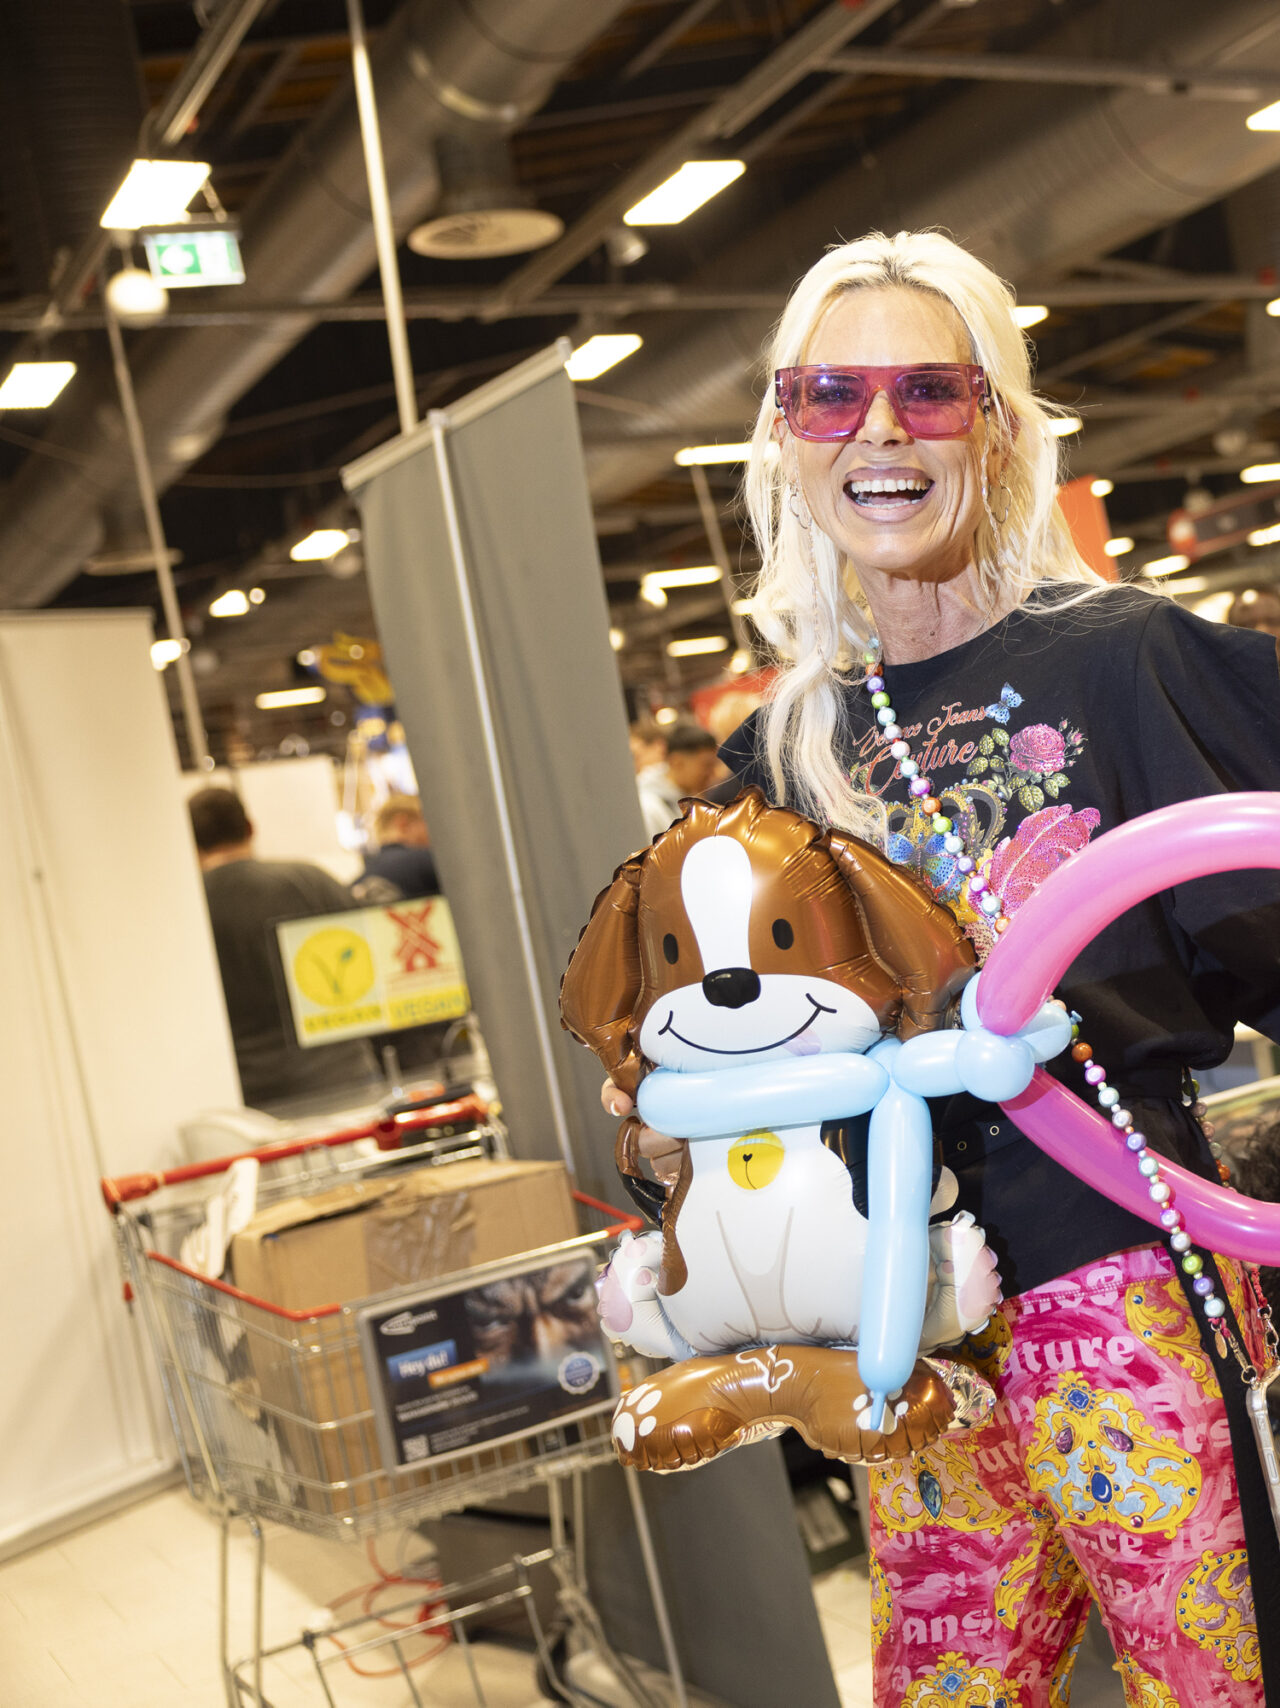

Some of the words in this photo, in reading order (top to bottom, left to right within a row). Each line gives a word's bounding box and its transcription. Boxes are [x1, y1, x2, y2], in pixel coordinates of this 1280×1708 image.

[927, 701, 987, 736] Jeans
[398, 1360, 427, 1379] Hey
[425, 1350, 450, 1371] du!
